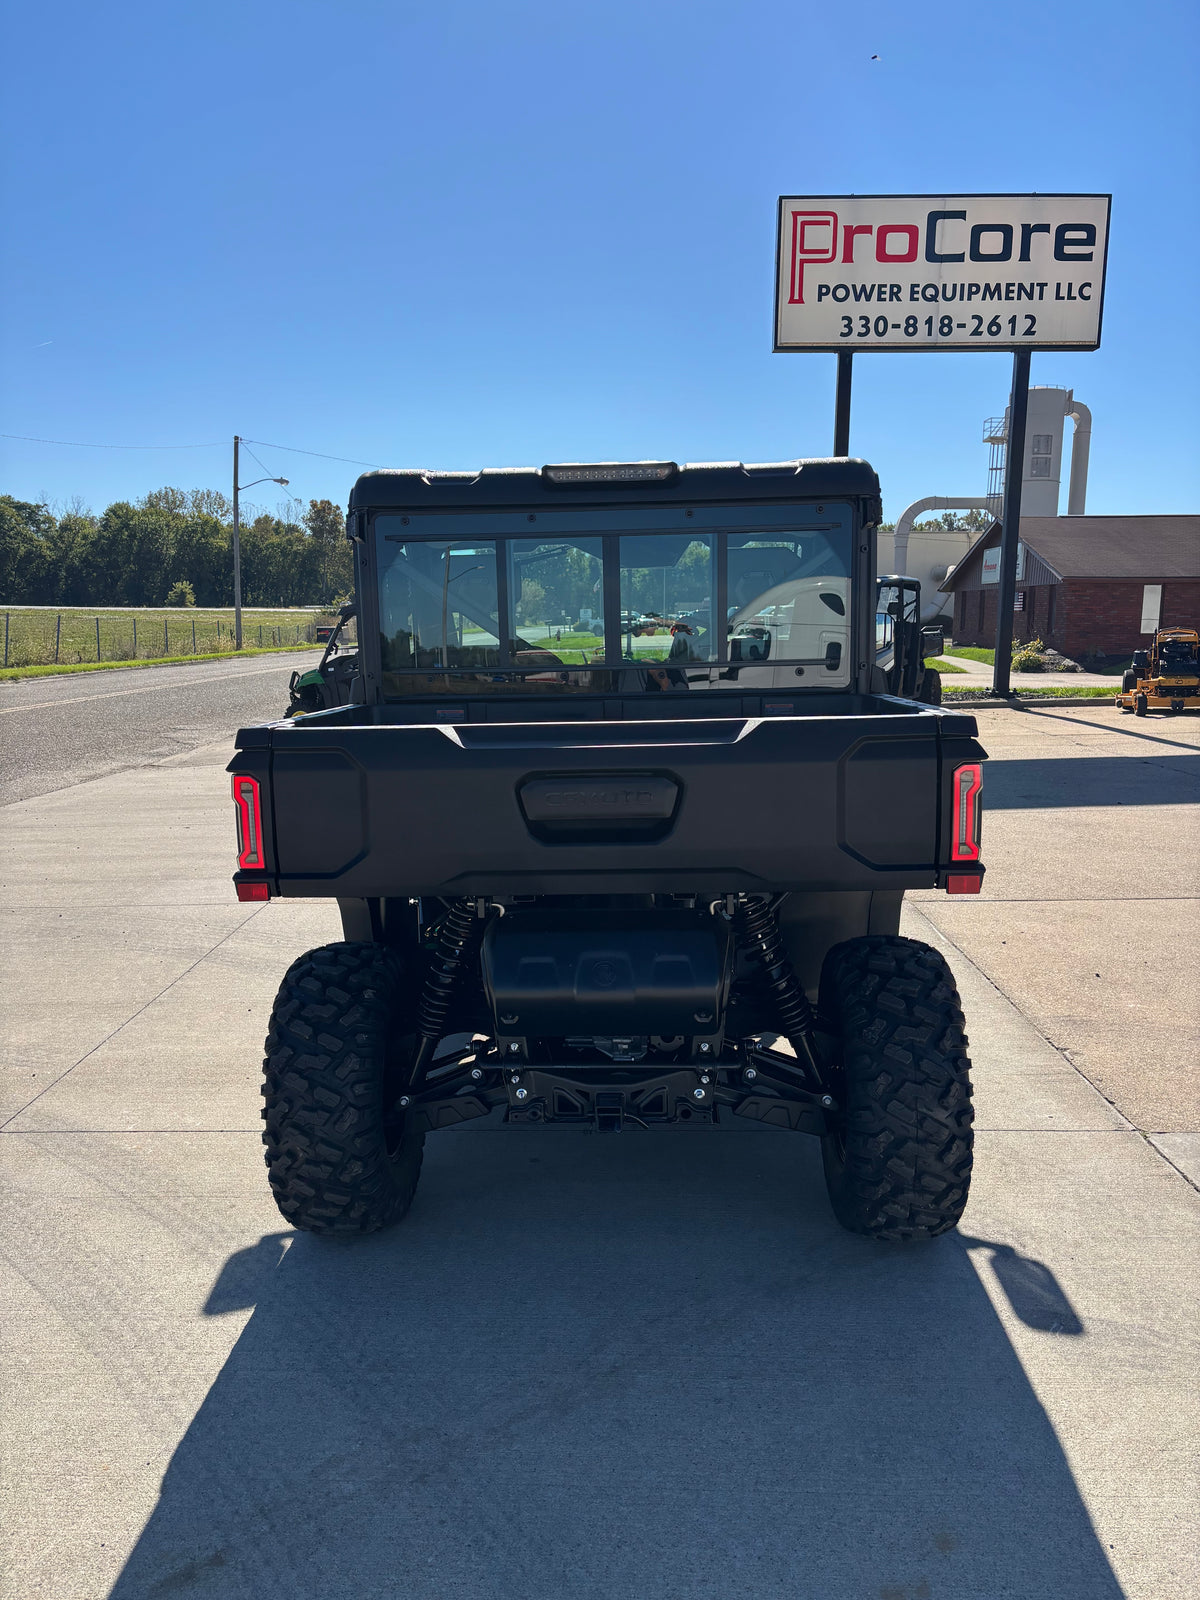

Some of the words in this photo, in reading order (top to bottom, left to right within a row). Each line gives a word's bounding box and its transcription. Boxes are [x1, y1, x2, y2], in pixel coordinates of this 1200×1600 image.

[787, 210, 1097, 304] ProCore
[817, 283, 903, 303] POWER
[909, 282, 1048, 303] EQUIPMENT
[1054, 282, 1092, 301] LLC
[839, 314, 1038, 338] 330-818-2612
